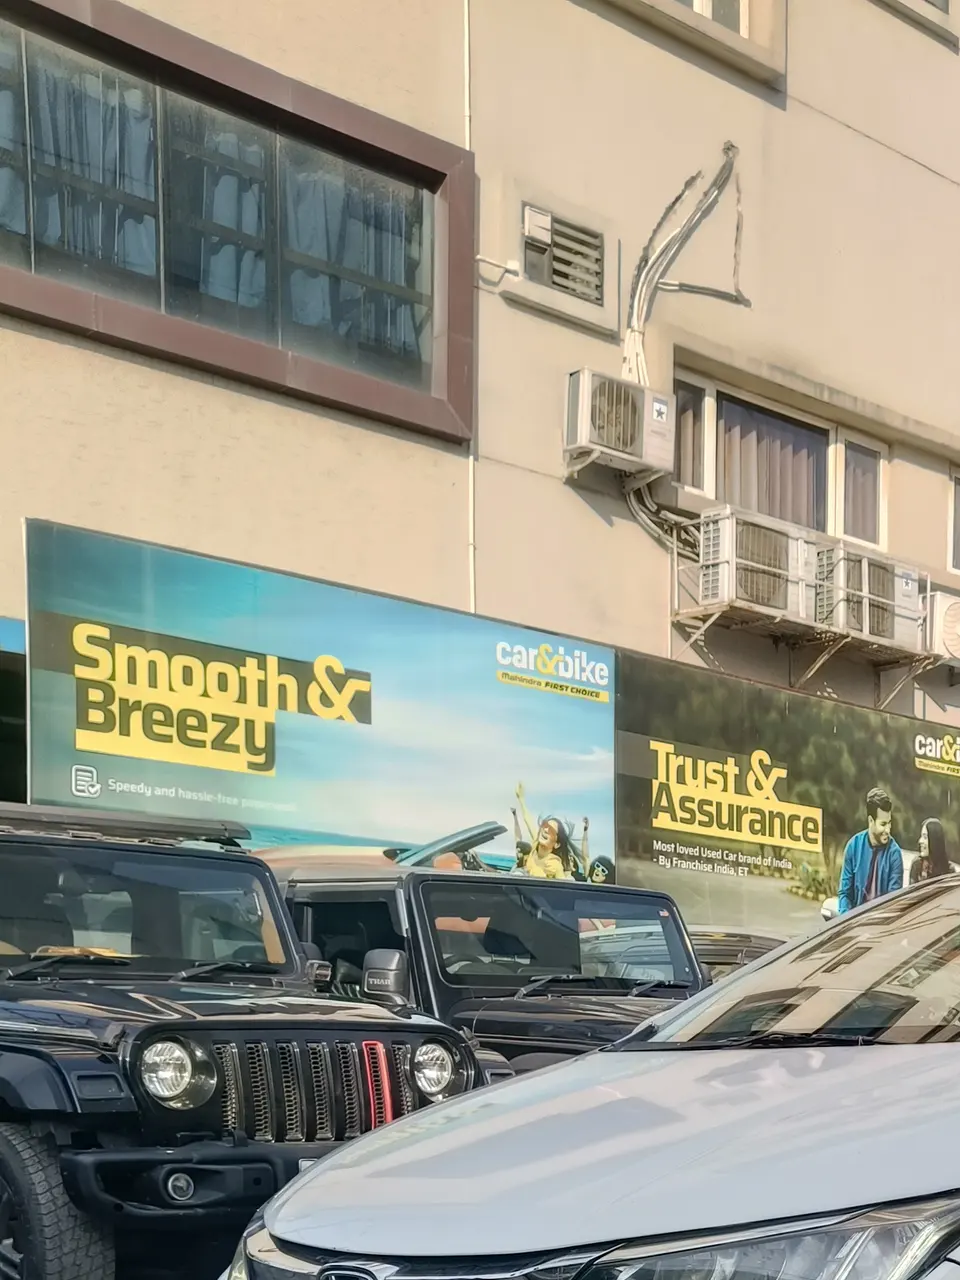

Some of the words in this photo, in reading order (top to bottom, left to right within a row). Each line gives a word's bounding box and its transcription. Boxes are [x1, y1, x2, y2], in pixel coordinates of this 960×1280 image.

[72, 623, 298, 712] Smooth
[306, 654, 371, 724] &
[496, 641, 609, 686] car&bike
[501, 672, 542, 687] Mahindra
[544, 681, 569, 692] FIRST
[570, 687, 600, 699] CHOICE
[76, 678, 276, 772] Breezy
[108, 779, 151, 797] Speedy
[154, 787, 176, 798] and
[178, 788, 239, 806] hassle-free
[649, 740, 739, 793] Trust
[746, 749, 788, 801] &
[650, 782, 819, 844] Assurance
[653, 840, 675, 853] Most
[676, 843, 700, 857] loved
[701, 847, 722, 860] Used
[723, 851, 737, 862] Car
[738, 852, 762, 865] brand
[763, 856, 772, 866] of
[773, 858, 793, 870] India
[658, 855, 671, 869] By
[672, 857, 712, 873] Franchise
[714, 863, 737, 877] India,
[738, 867, 749, 877] ET
